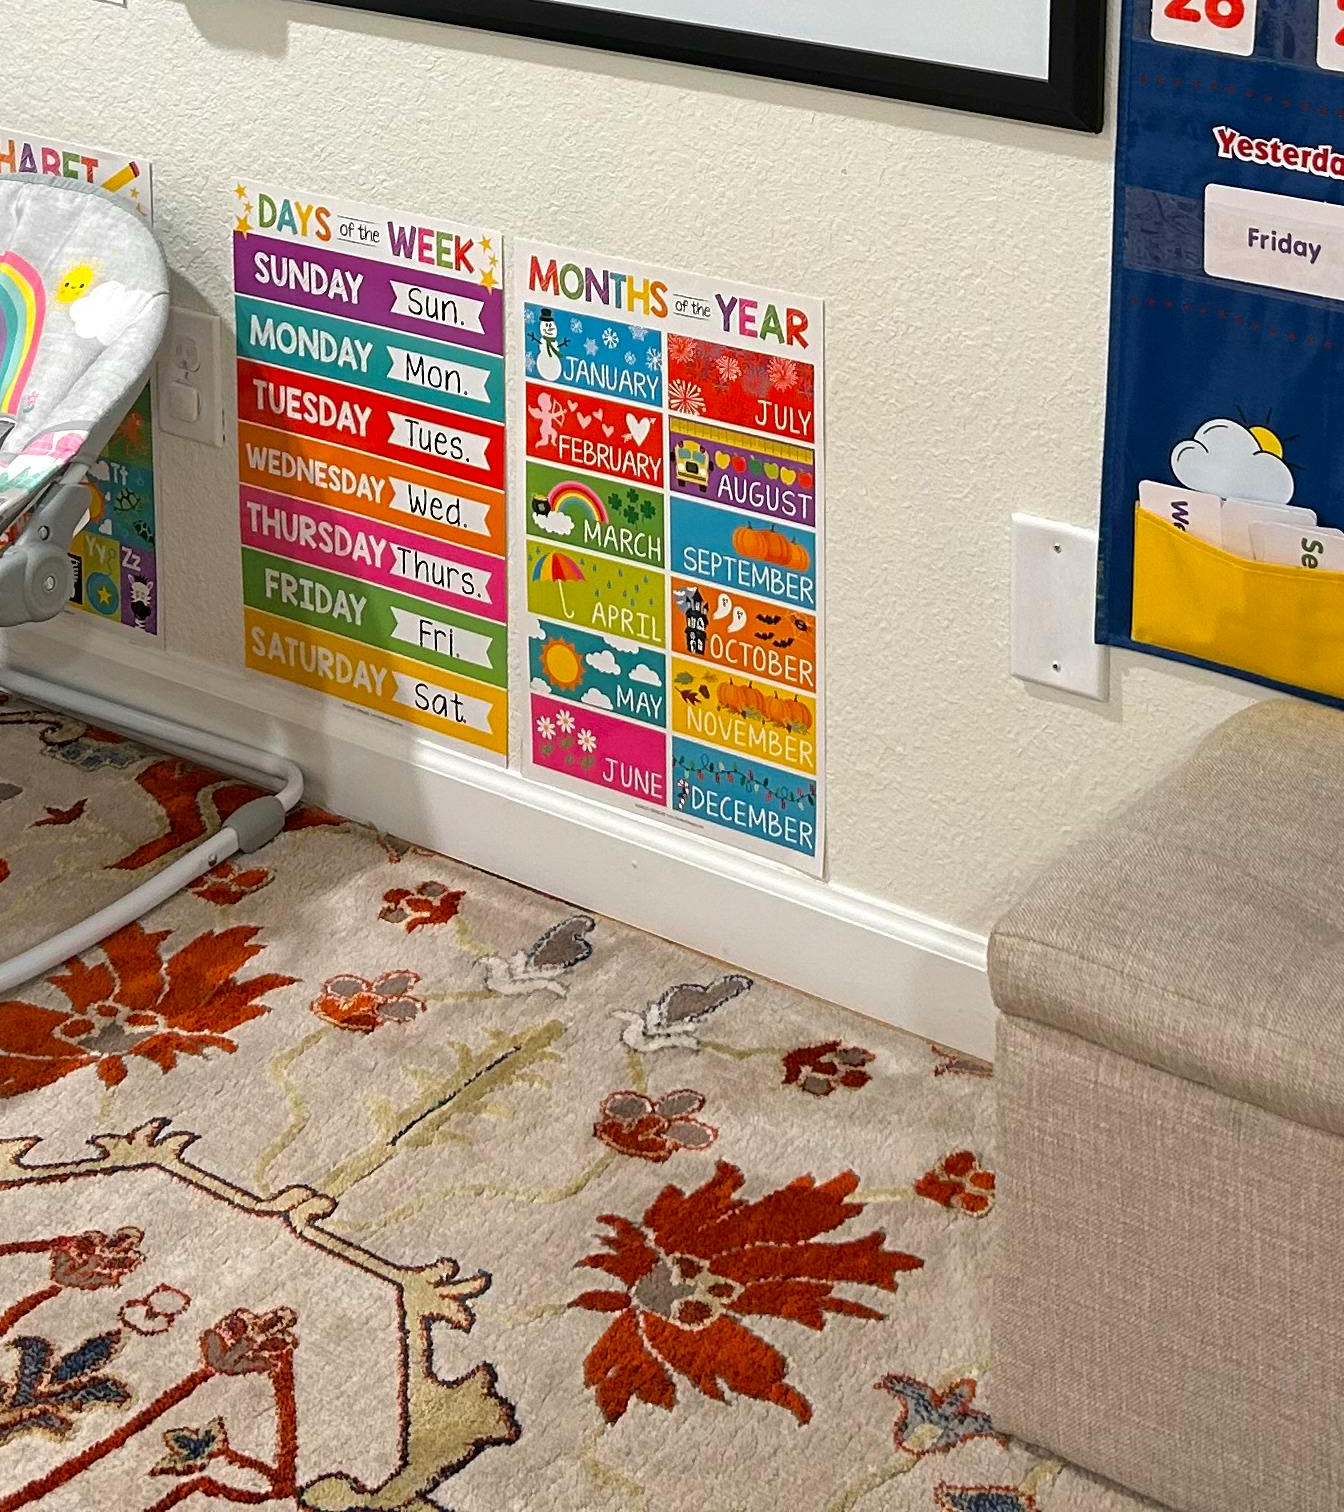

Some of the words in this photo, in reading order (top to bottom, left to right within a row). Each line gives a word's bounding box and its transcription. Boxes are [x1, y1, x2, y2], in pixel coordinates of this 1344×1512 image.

[257, 192, 333, 243] DAYS
[338, 223, 356, 240] of
[356, 224, 380, 244] the
[387, 222, 475, 273] WEEK
[1247, 227, 1322, 264] Friday
[254, 252, 364, 304] SUNDAY
[408, 294, 465, 325] Sun.
[528, 255, 668, 318] MONTHS
[674, 299, 691, 314] of
[691, 300, 712, 318] the
[715, 293, 810, 349] YEAR
[248, 314, 374, 372] MONDAY
[405, 354, 468, 396] Mon.
[563, 355, 660, 400] JANUARY
[252, 380, 372, 438] TUESDAY
[404, 418, 470, 462] Tues.
[754, 399, 811, 436] JULY
[558, 434, 661, 479] FEBRUARY
[246, 443, 386, 504] WEDNESDAY
[408, 484, 469, 527] Wed.
[716, 475, 812, 520] AUGUST
[121, 546, 141, 571] Zz
[246, 502, 389, 570] THURSDAY
[396, 548, 482, 598] Thurs.
[583, 522, 662, 561] MARCH
[683, 548, 814, 603] SEPTEMBER
[264, 568, 368, 626] FRIDAY
[419, 619, 460, 658] Fri.
[591, 604, 662, 642] APRIL
[250, 627, 388, 696] SATURDAY
[415, 683, 467, 723] Sat.
[710, 634, 814, 685] OCTOBER
[615, 685, 662, 718] MAY
[686, 711, 814, 766] NOVEMBER
[602, 756, 664, 798] JUNE
[689, 783, 814, 849] DECEMBER
